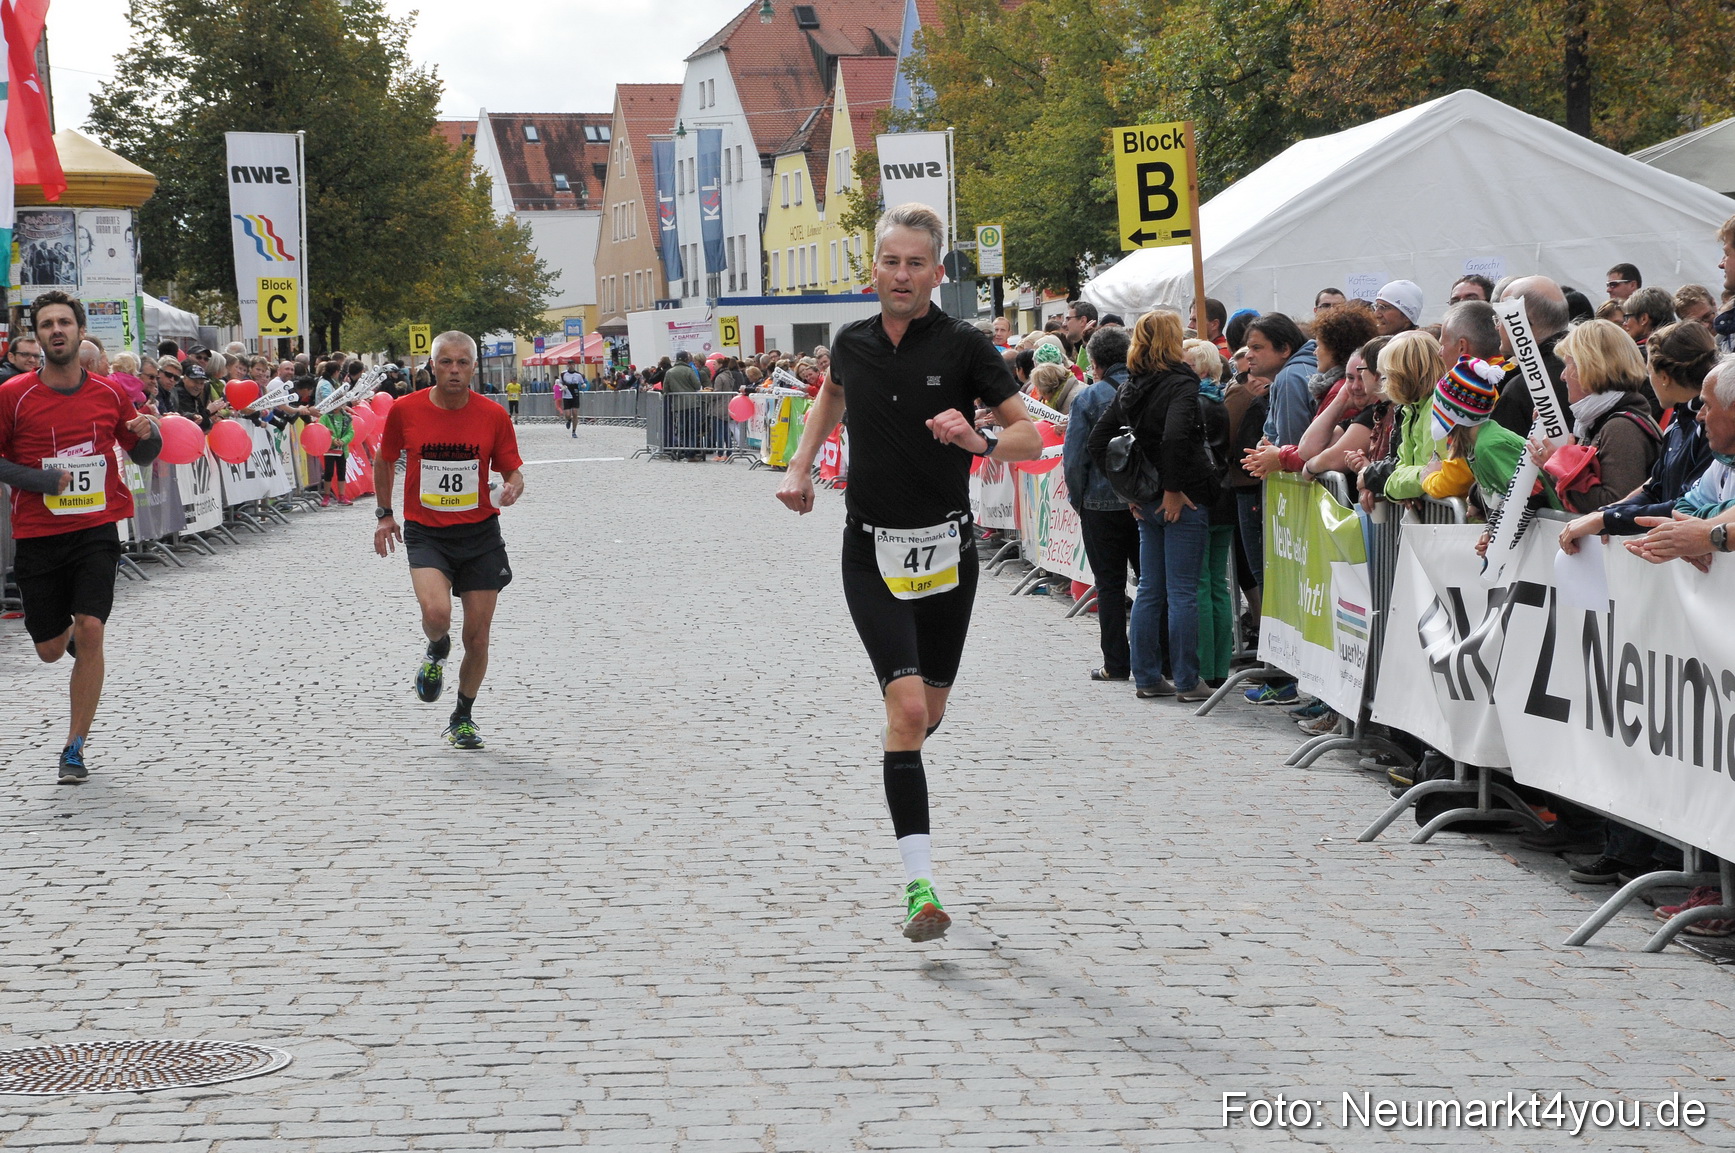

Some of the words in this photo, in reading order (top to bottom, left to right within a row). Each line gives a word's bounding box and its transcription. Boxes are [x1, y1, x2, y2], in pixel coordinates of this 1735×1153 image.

[1122, 128, 1185, 154] Block
[1136, 161, 1179, 223] B
[1465, 258, 1500, 271] Gnocchi
[261, 279, 293, 291] Block
[266, 294, 288, 324] C
[720, 316, 737, 324] Block
[724, 325, 735, 341] D
[415, 334, 426, 349] D
[1504, 311, 1547, 393] Laufsport
[1533, 395, 1564, 439] BMW
[67, 447, 84, 457] DEHN
[43, 462, 67, 470] PARTL
[67, 461, 98, 469] Neumarkt
[422, 463, 441, 472] PARTL
[438, 473, 463, 493] 48
[59, 497, 94, 507] Matthias
[440, 496, 460, 505] Erich
[877, 535, 907, 544] PARTL
[908, 532, 946, 544] Neumarkt
[1272, 515, 1293, 560] Neue
[903, 545, 937, 574] 47
[910, 580, 933, 592] Lars
[902, 667, 918, 675] cep
